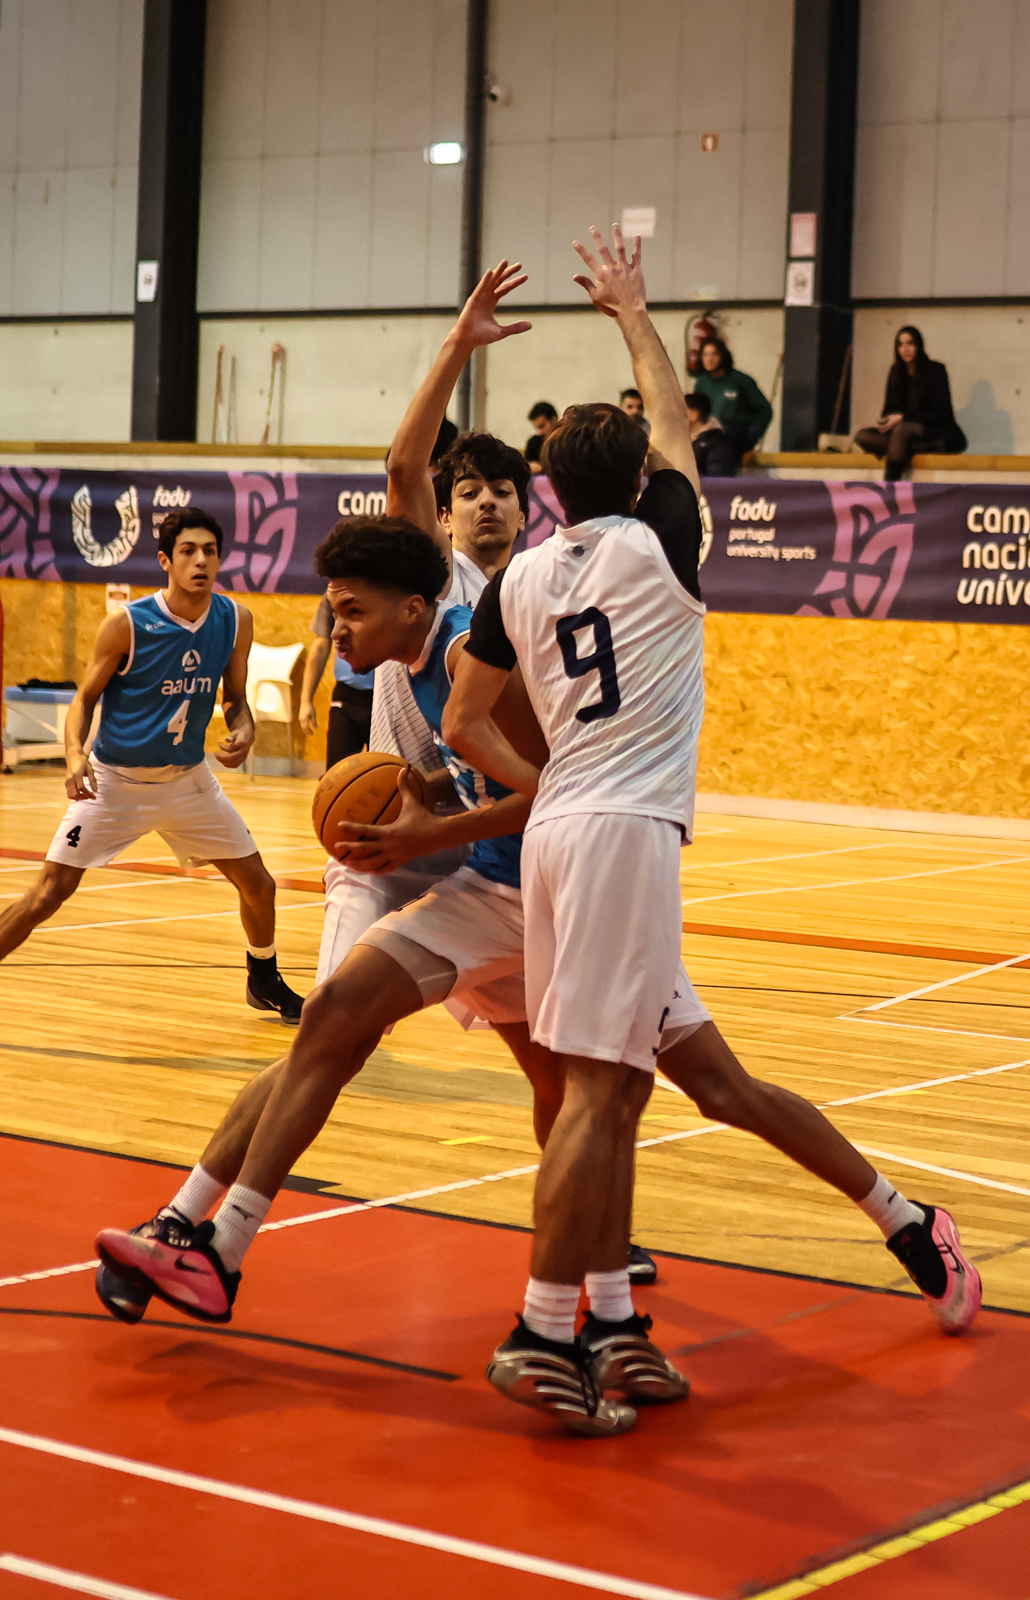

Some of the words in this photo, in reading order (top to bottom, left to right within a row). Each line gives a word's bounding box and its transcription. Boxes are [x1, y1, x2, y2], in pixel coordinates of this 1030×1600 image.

[152, 484, 192, 507] fadu
[730, 495, 777, 522] fadu
[728, 527, 776, 544] portugal
[726, 543, 780, 561] university
[781, 546, 817, 561] sports
[962, 536, 1030, 570] naci
[556, 606, 621, 724] 9
[161, 676, 212, 696] aaum
[167, 699, 191, 746] 4
[66, 824, 82, 848] 4
